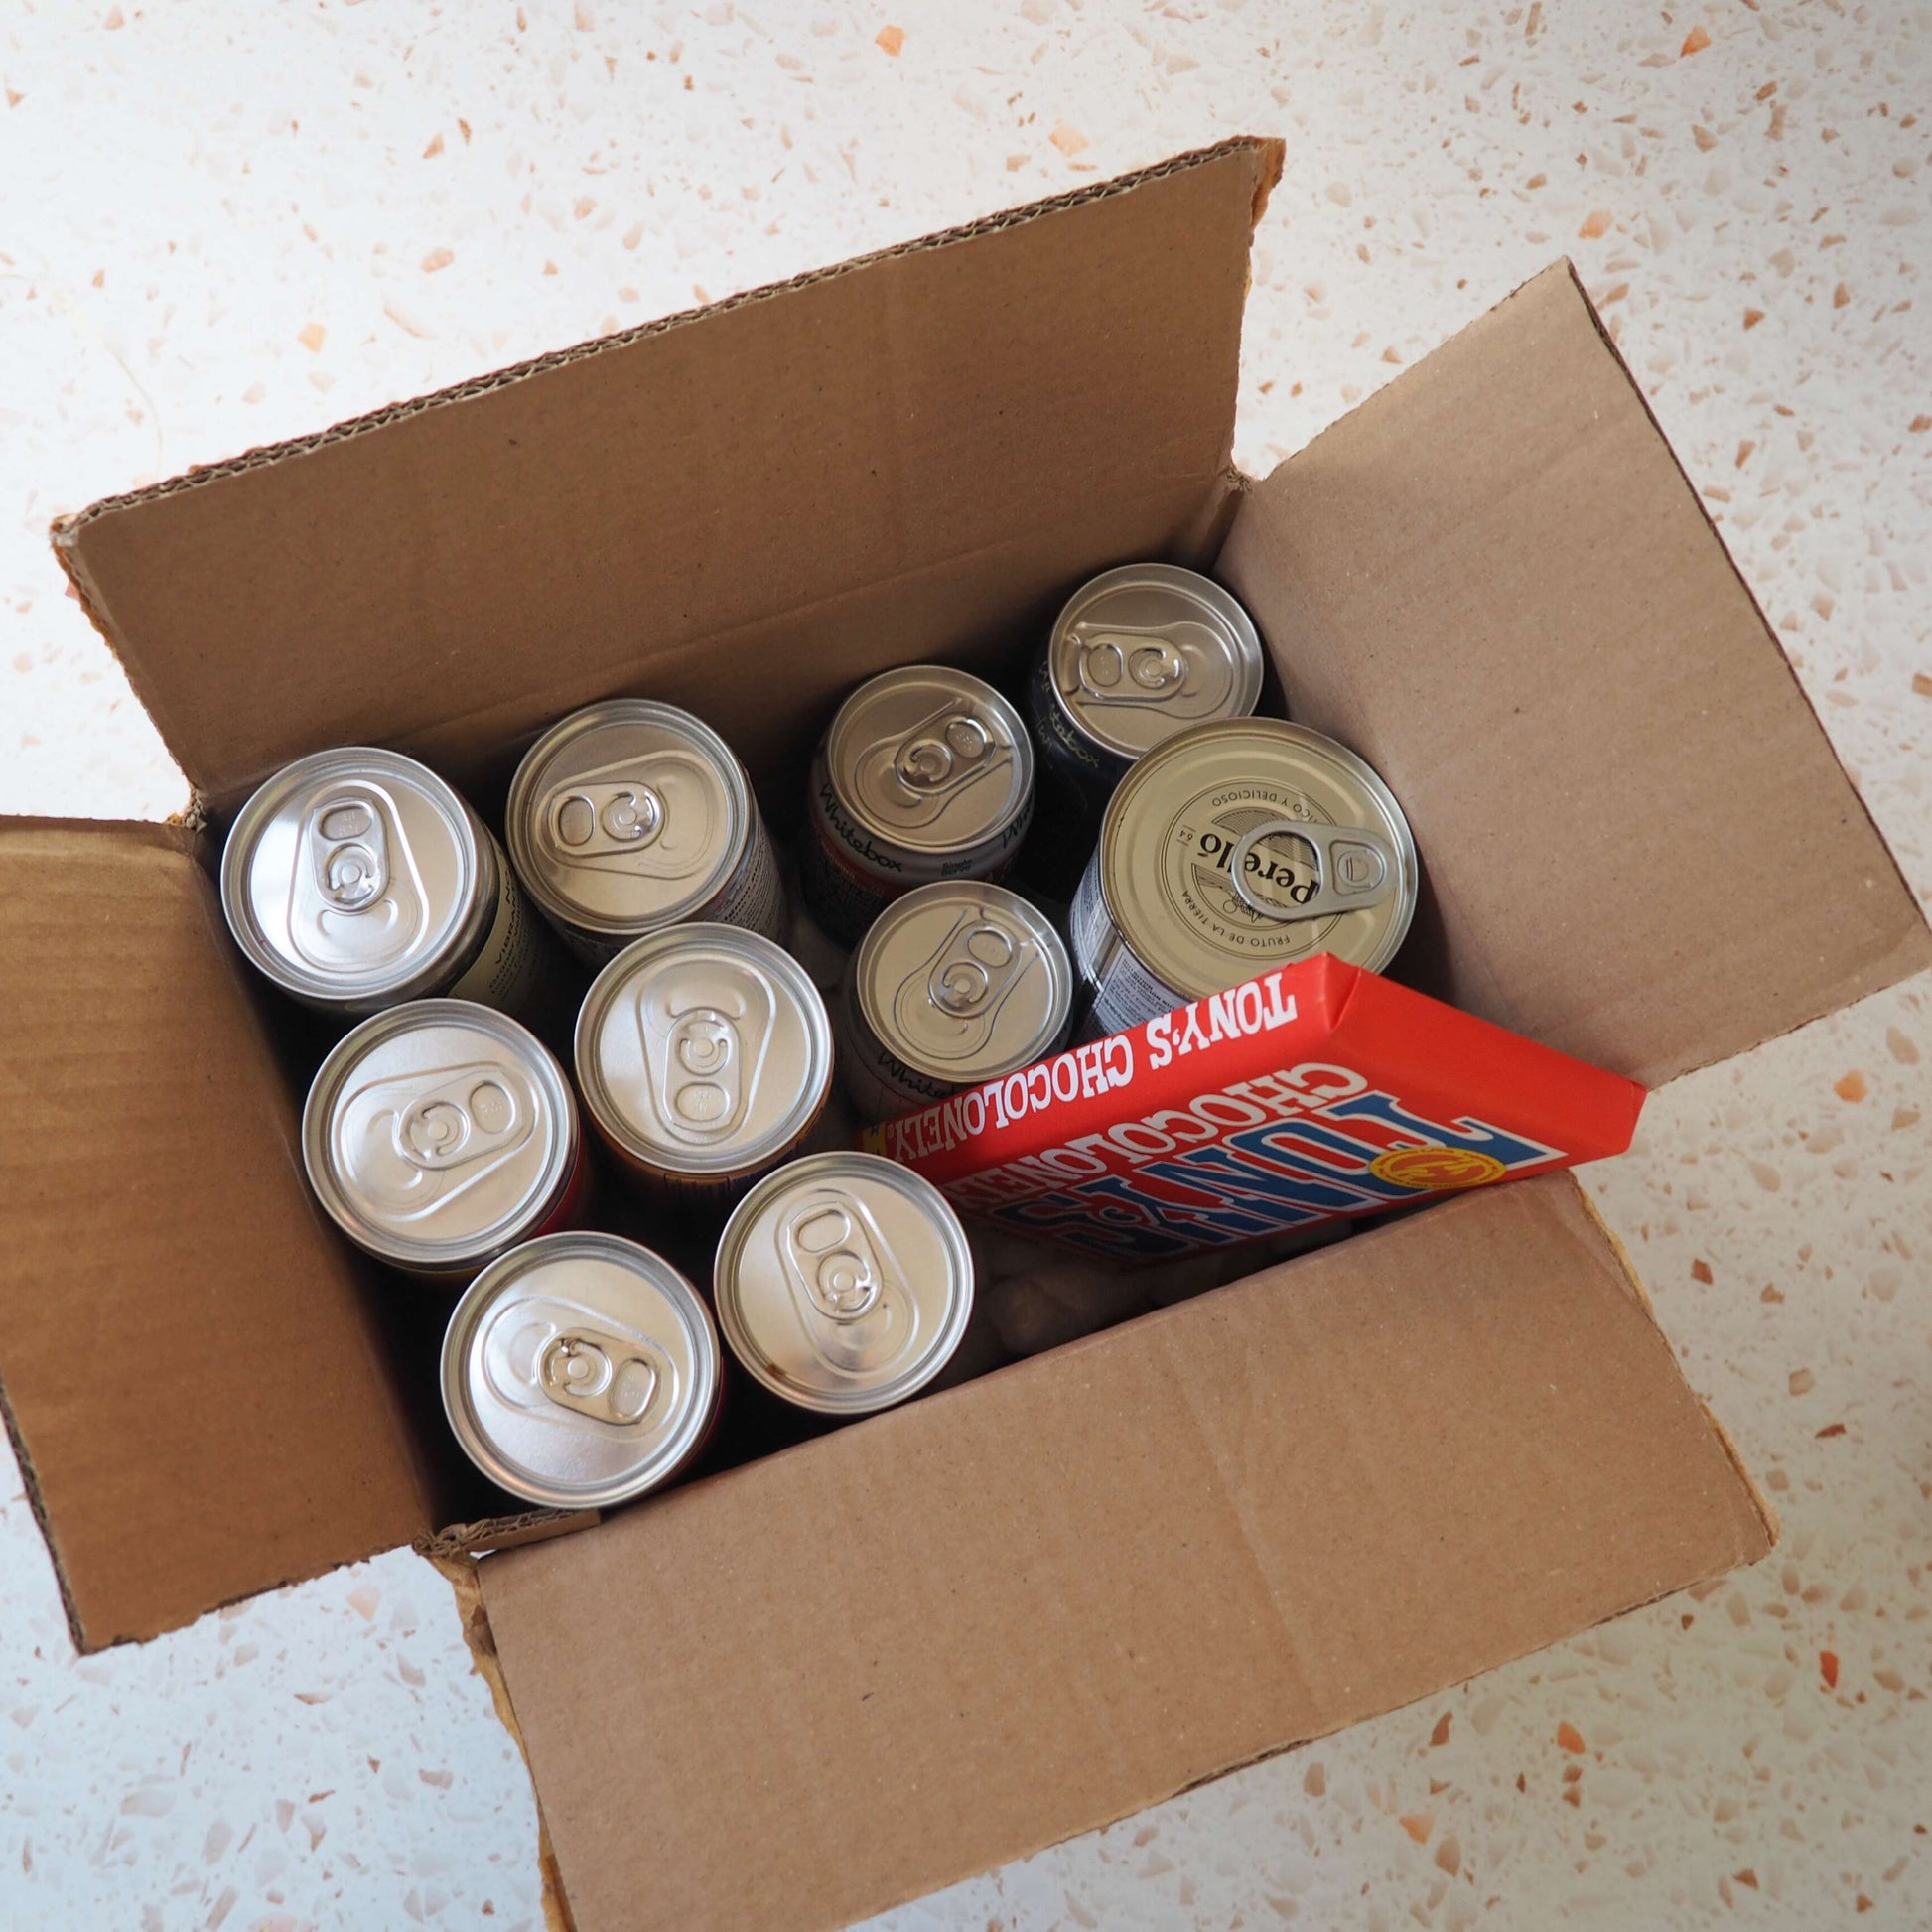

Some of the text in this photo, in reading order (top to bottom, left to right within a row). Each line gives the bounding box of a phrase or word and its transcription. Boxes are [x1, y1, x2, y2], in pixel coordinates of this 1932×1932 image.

[820, 783, 902, 873] Whitebox
[1212, 789, 1278, 808] DELICIOSO
[1282, 798, 1289, 807] Y
[1197, 832, 1320, 905] Pereló
[1181, 890, 1291, 947] FRUTO DE LA TIERRA
[1146, 972, 1298, 1070] TONY'S
[895, 1035, 1134, 1162] CHOCOLONELY
[939, 1062, 1368, 1210] CHOCOLONELY
[987, 1089, 1570, 1262] TONY'S
